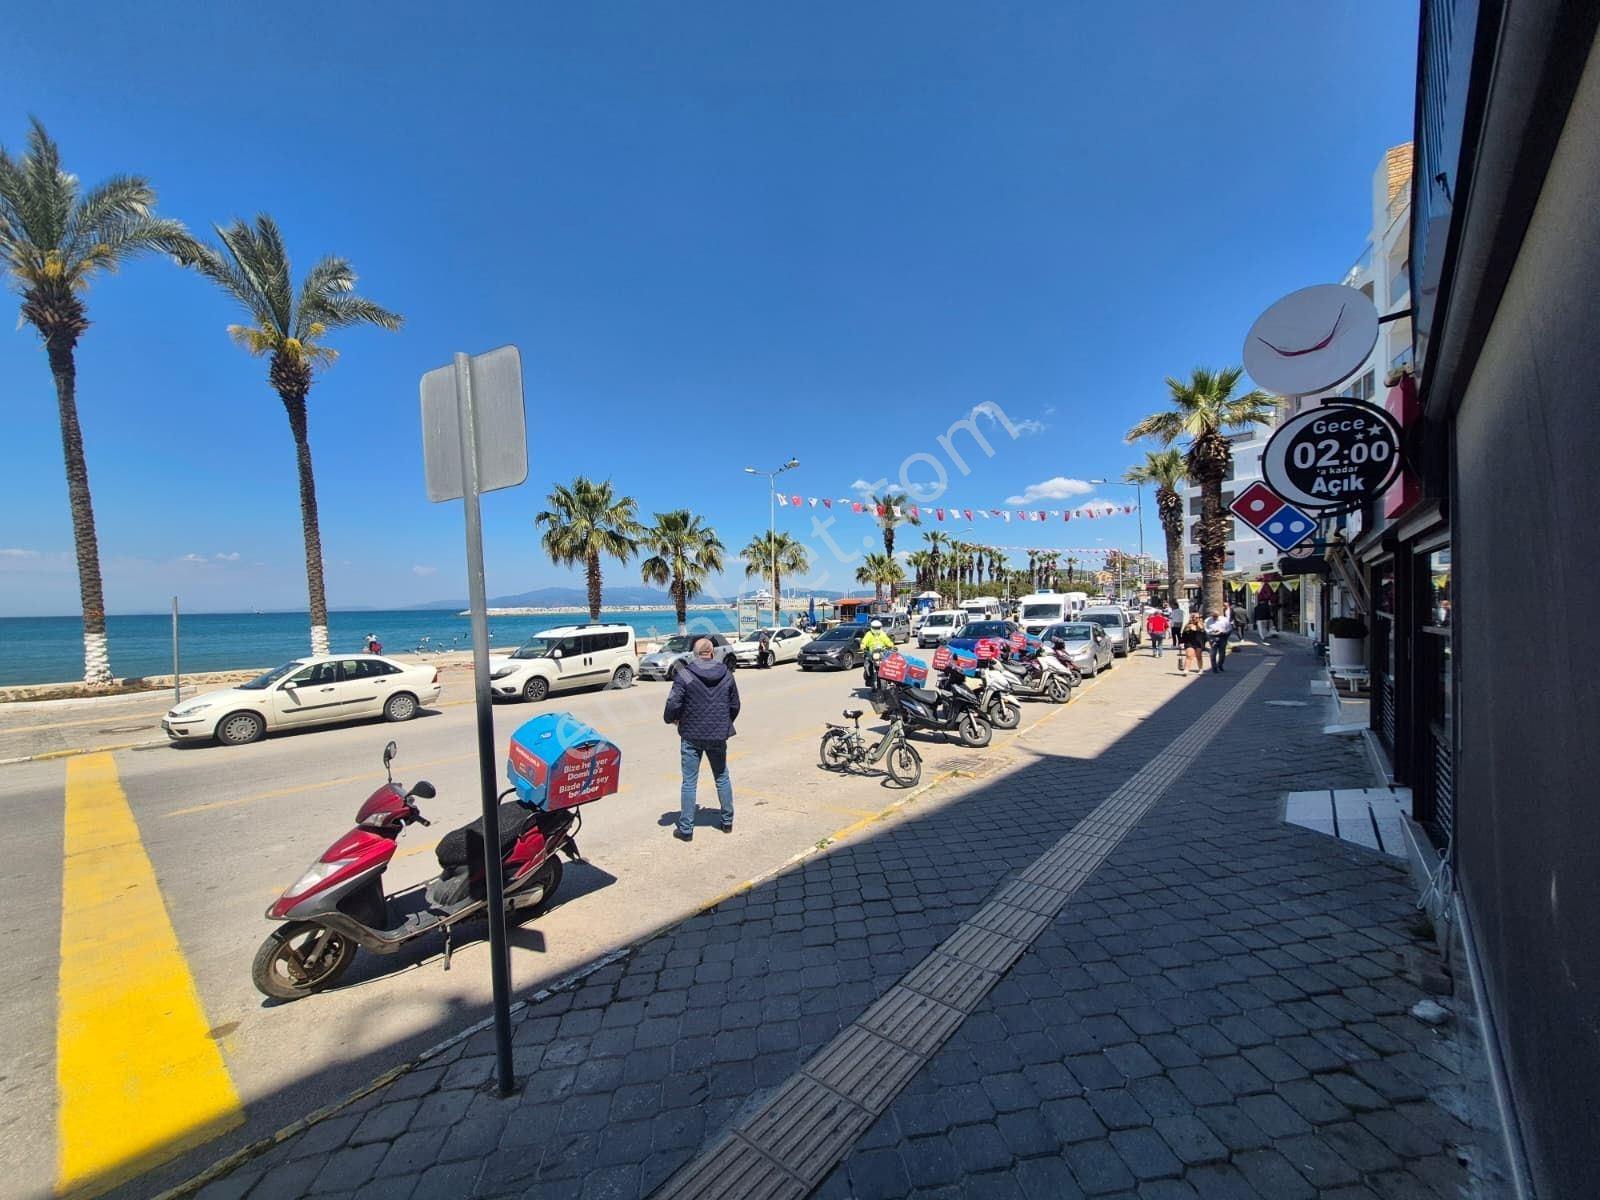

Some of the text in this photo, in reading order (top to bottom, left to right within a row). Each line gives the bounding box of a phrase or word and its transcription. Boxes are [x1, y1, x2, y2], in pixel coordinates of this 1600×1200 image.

[1313, 419, 1365, 434] Gece
[1293, 439, 1389, 469] 02:00
[1329, 466, 1359, 474] kadar
[1311, 474, 1365, 497] Açık
[567, 766, 604, 780] Domio's
